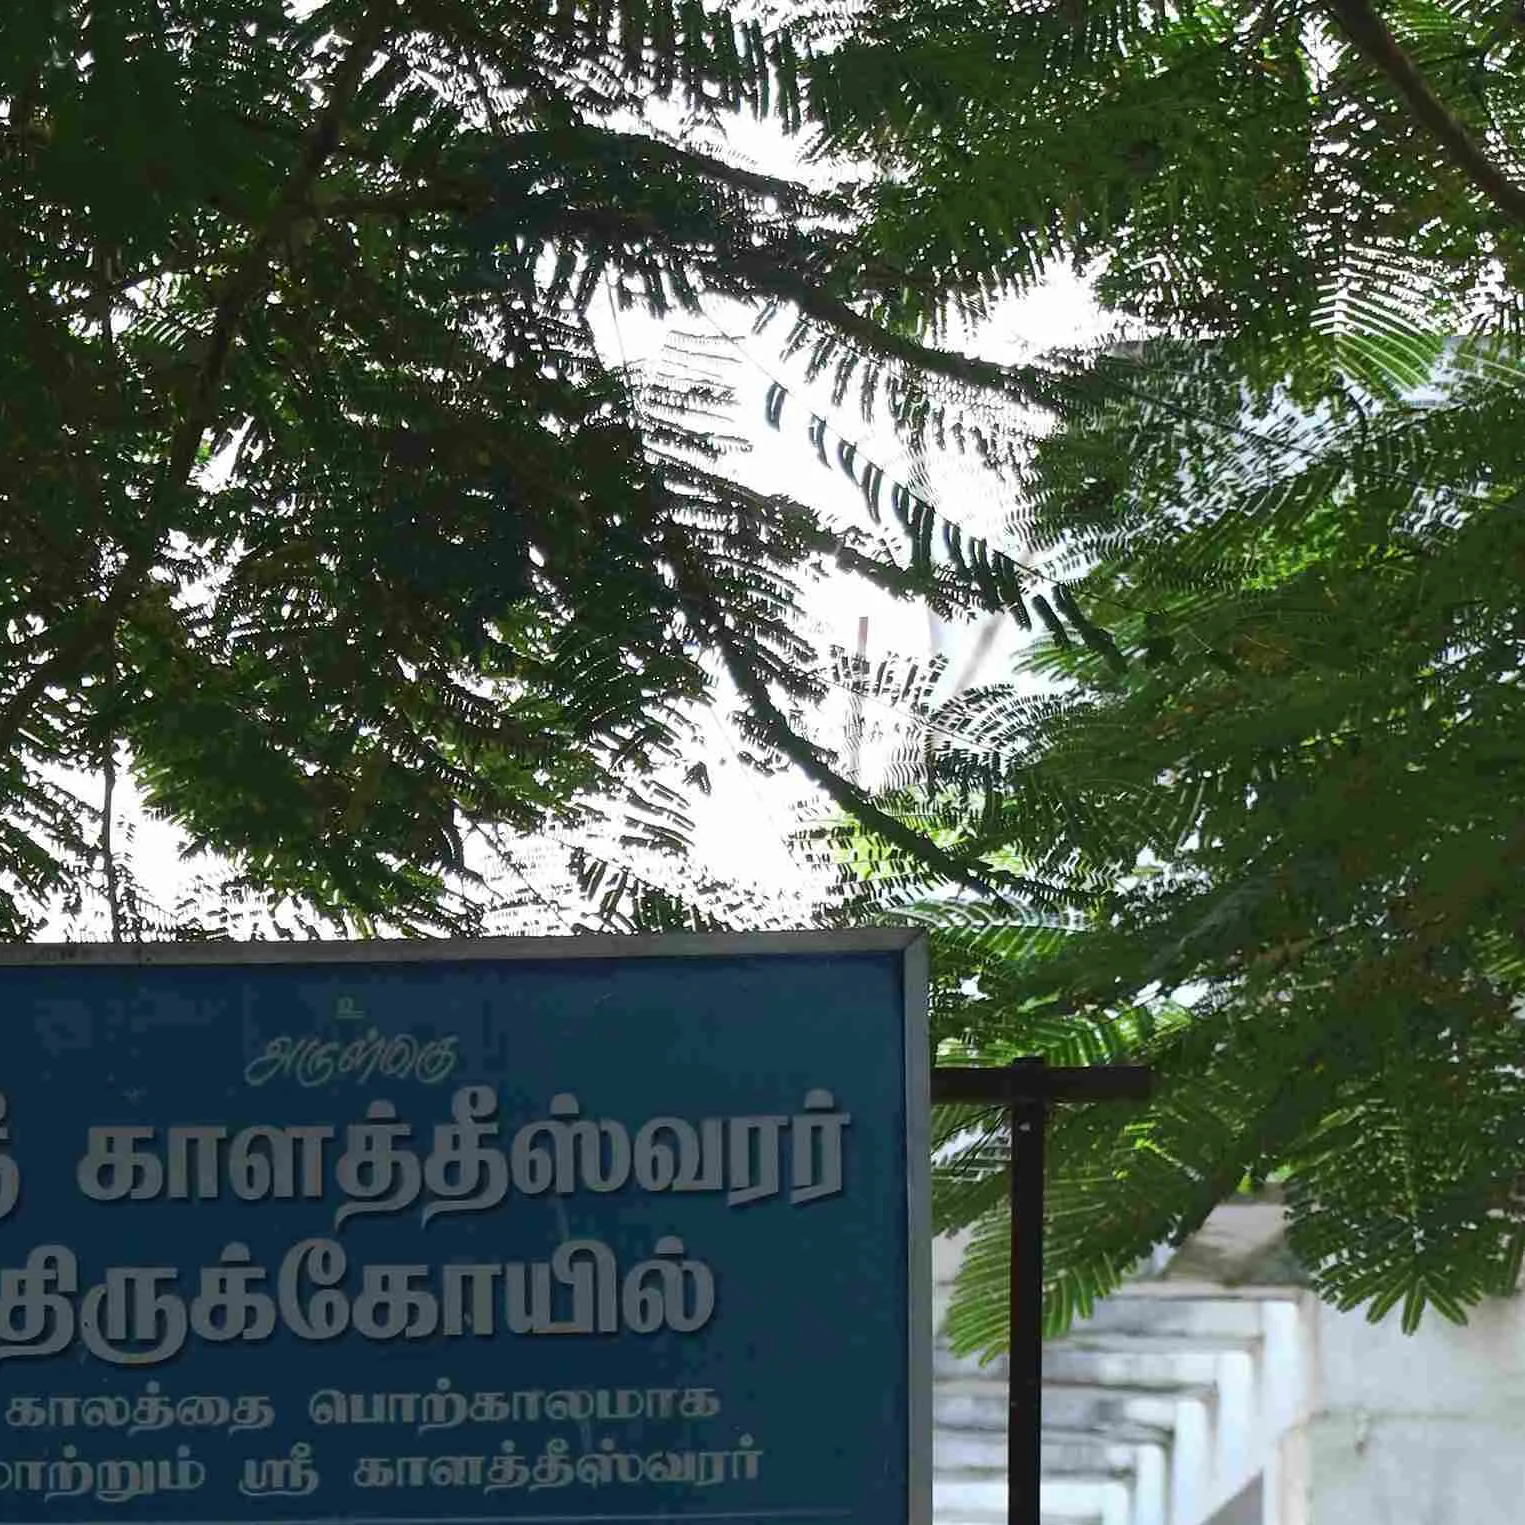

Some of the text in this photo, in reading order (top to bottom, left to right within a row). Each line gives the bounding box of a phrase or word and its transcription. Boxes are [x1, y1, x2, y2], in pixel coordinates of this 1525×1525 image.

[77, 1085, 851, 1228] காளத்தீஸ்வரர்
[4, 1377, 721, 1436] காலத்தை பொற்காலமாக
[352, 1434, 764, 1495] காளத்தீஸ்வரர்
